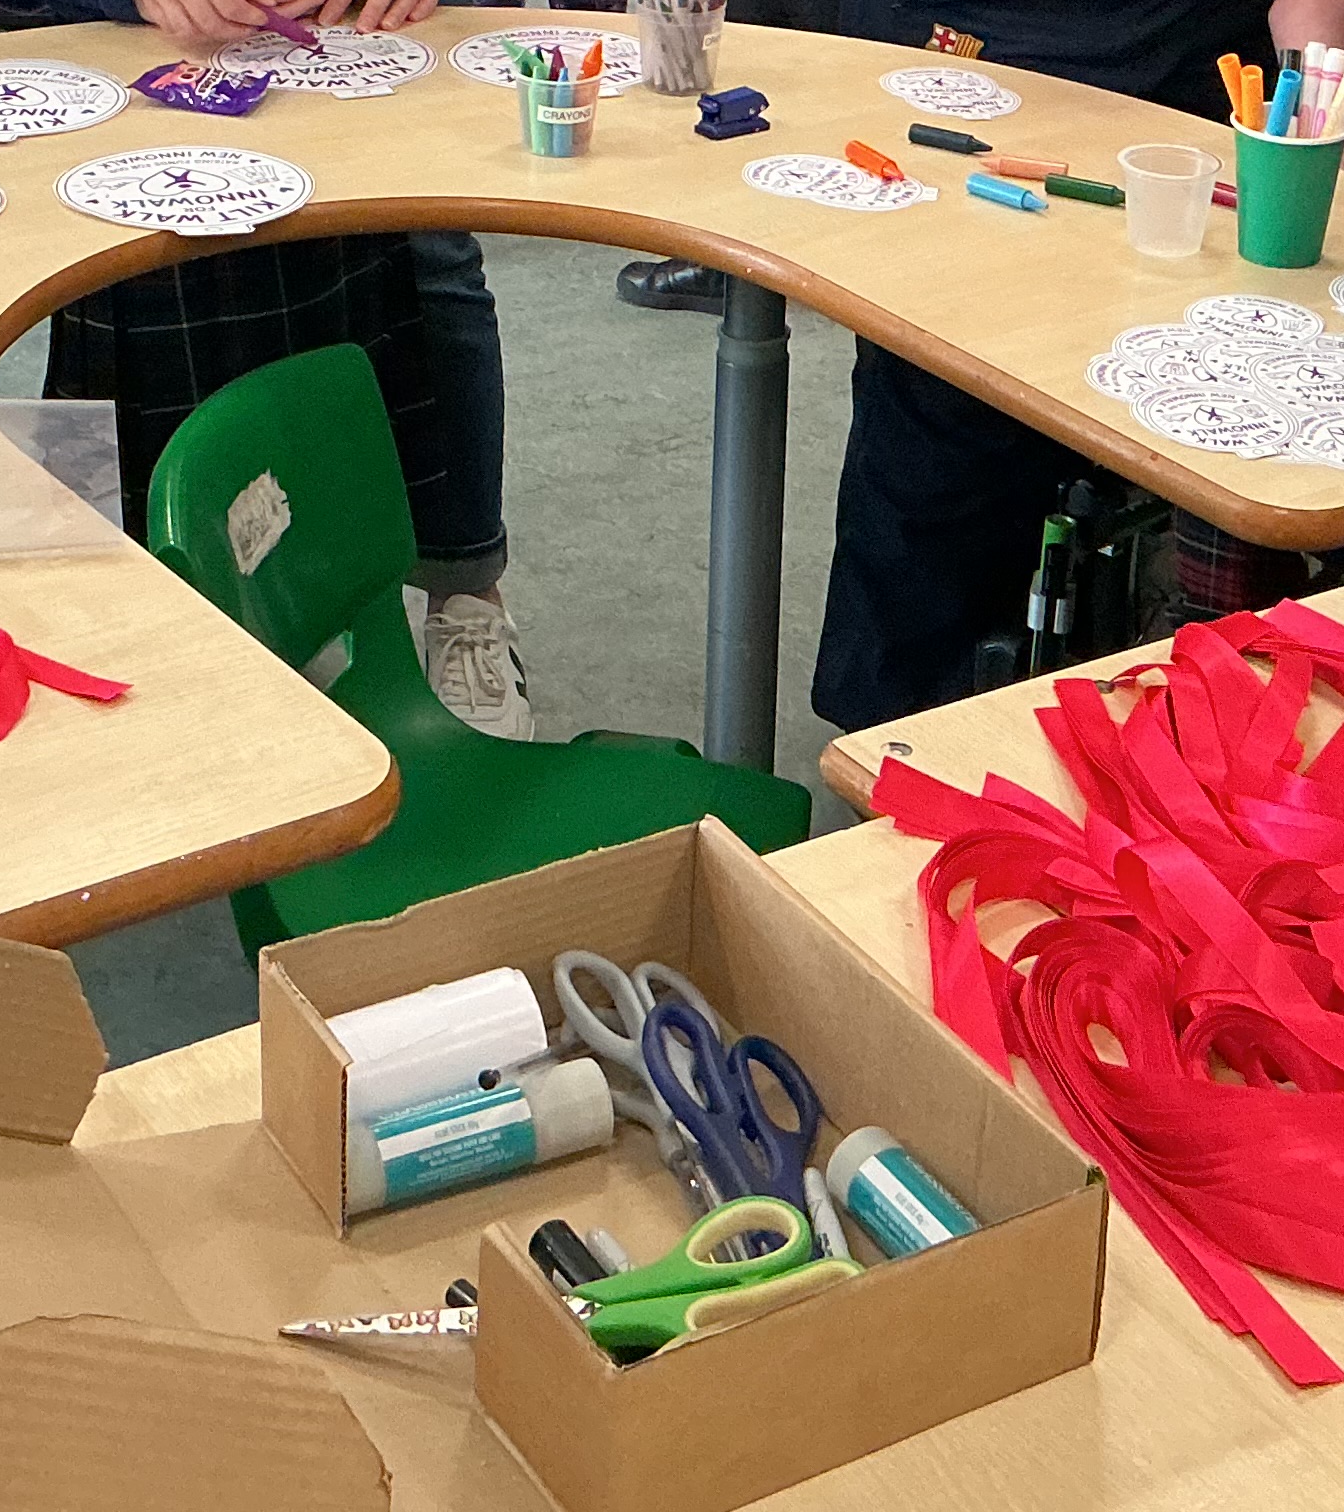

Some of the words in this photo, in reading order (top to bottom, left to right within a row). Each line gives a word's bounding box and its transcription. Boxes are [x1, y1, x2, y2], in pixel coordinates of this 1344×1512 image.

[269, 78, 351, 88] WALK
[358, 67, 412, 85] KILT
[543, 108, 592, 120] CRAYONS
[96, 150, 192, 170] INNOWALK
[199, 150, 243, 160] NEW
[109, 189, 267, 210] INNOWALK
[111, 208, 205, 224] WALK
[182, 205, 216, 213] FOR
[218, 200, 281, 222] KILT
[1205, 315, 1284, 338] INNOWALK
[1185, 421, 1270, 437] INNOWALK
[1251, 429, 1283, 445] KILT
[1195, 436, 1249, 447] WALK
